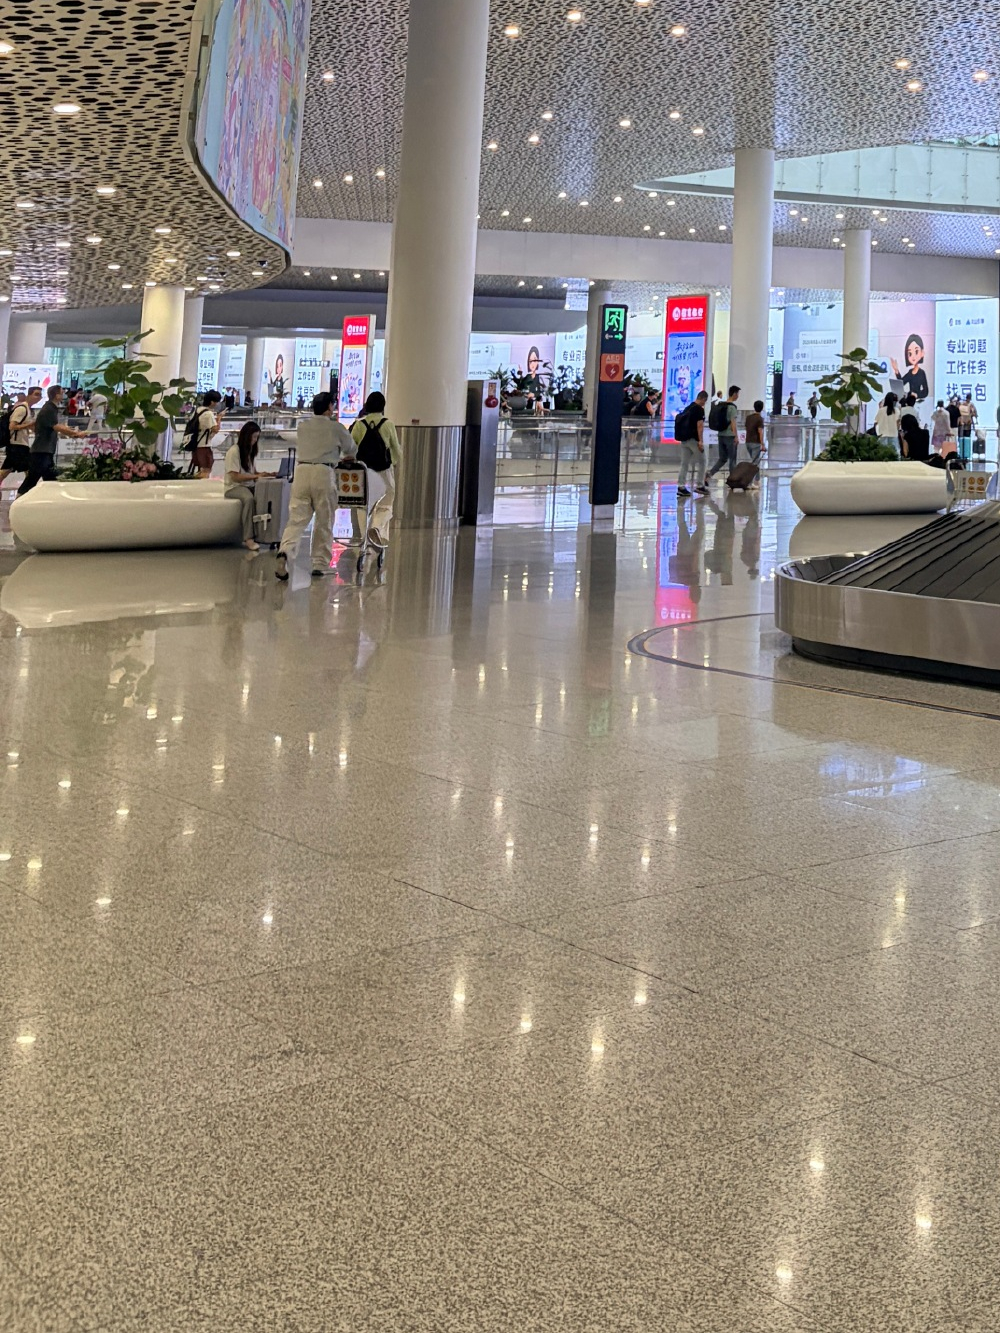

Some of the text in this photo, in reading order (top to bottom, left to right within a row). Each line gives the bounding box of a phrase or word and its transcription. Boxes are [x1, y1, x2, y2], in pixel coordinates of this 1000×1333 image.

[946, 339, 987, 354] 专业问题
[946, 360, 987, 374] 工作任务
[946, 383, 987, 402] 找豆包
